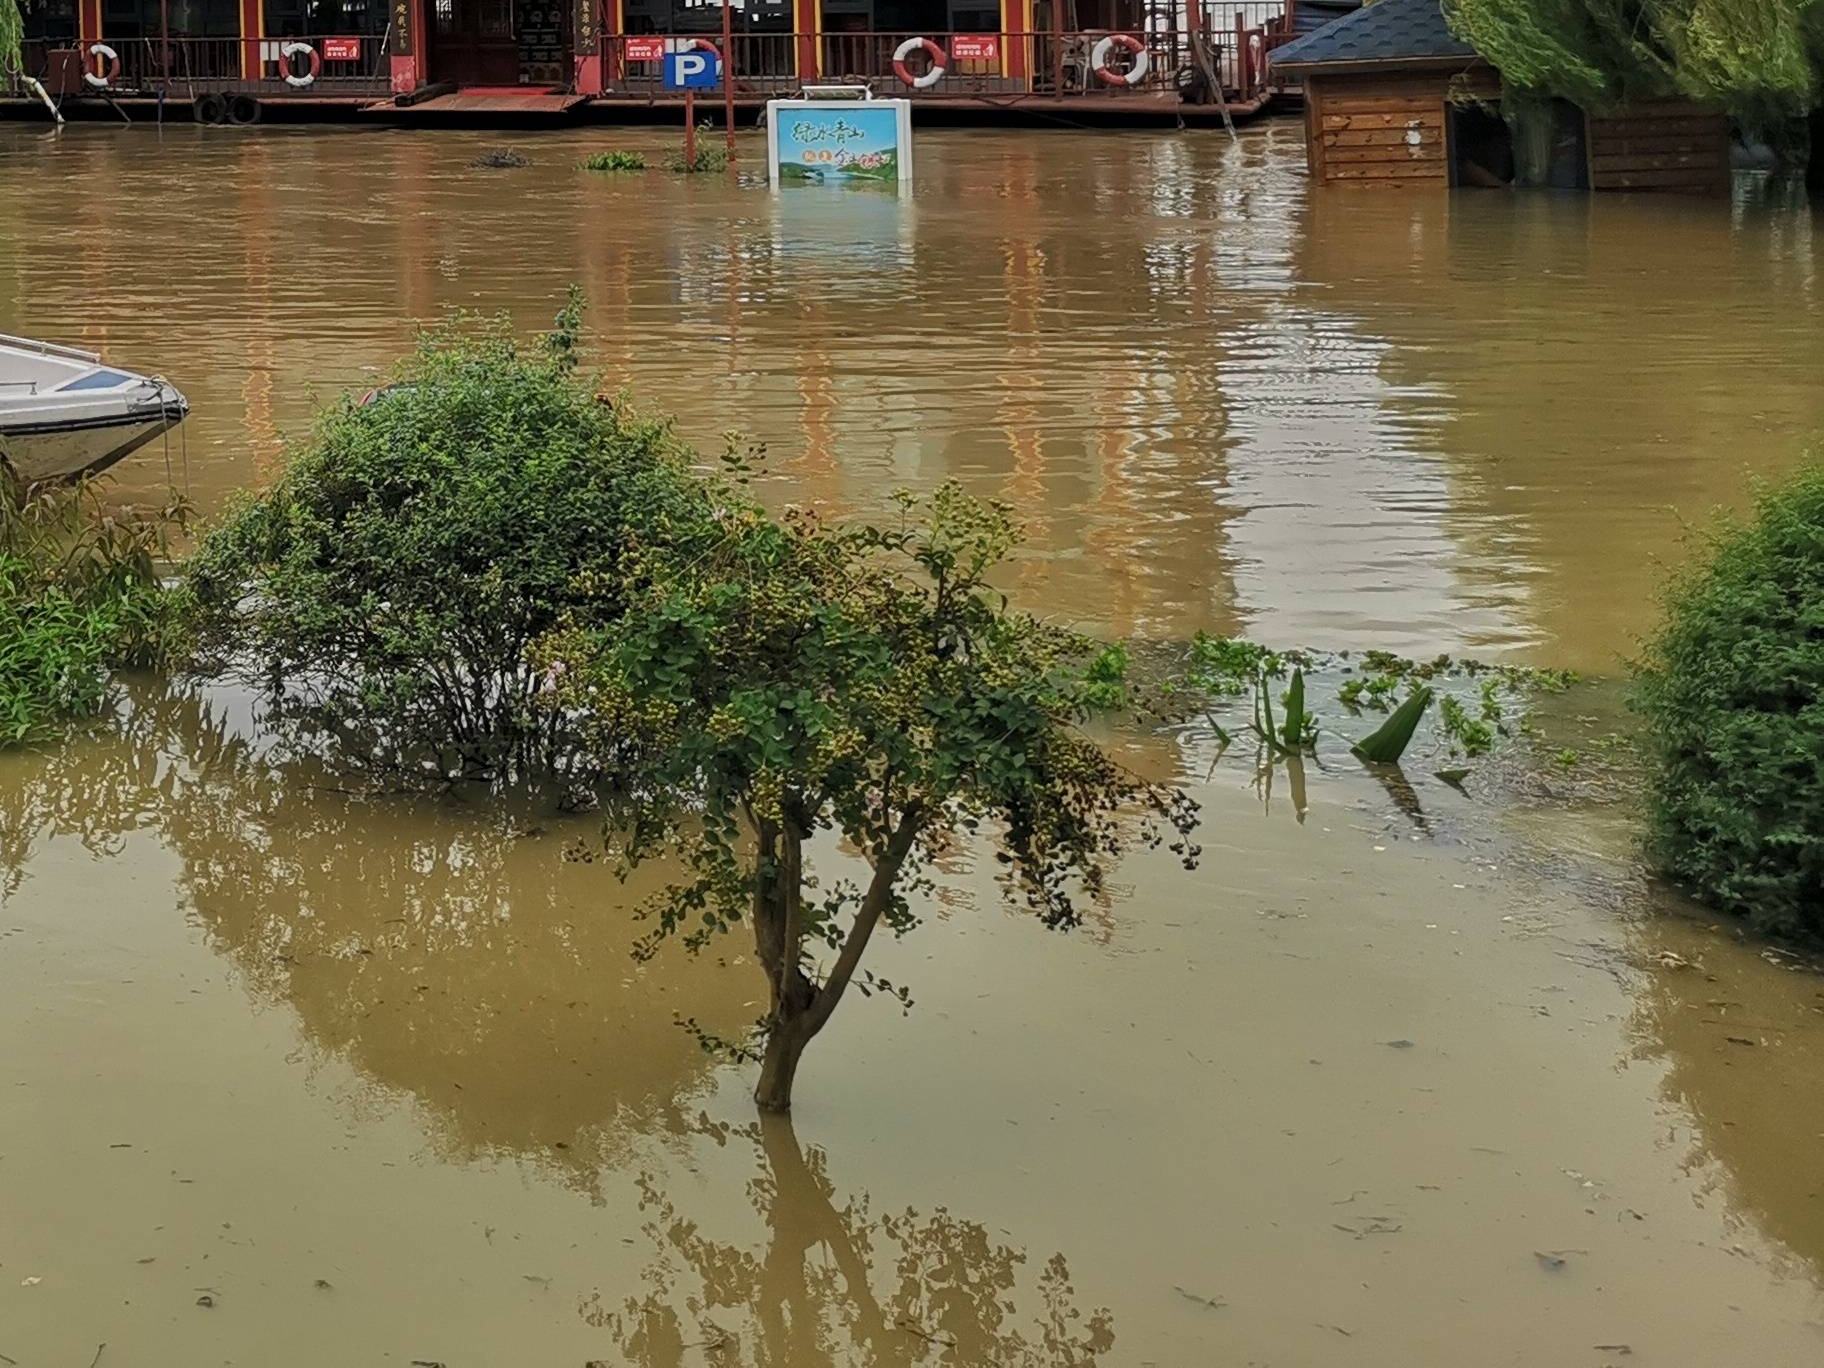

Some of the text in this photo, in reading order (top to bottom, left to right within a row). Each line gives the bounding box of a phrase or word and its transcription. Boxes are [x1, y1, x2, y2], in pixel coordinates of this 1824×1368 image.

[675, 55, 706, 85] P
[792, 119, 865, 144] 绿水青山
